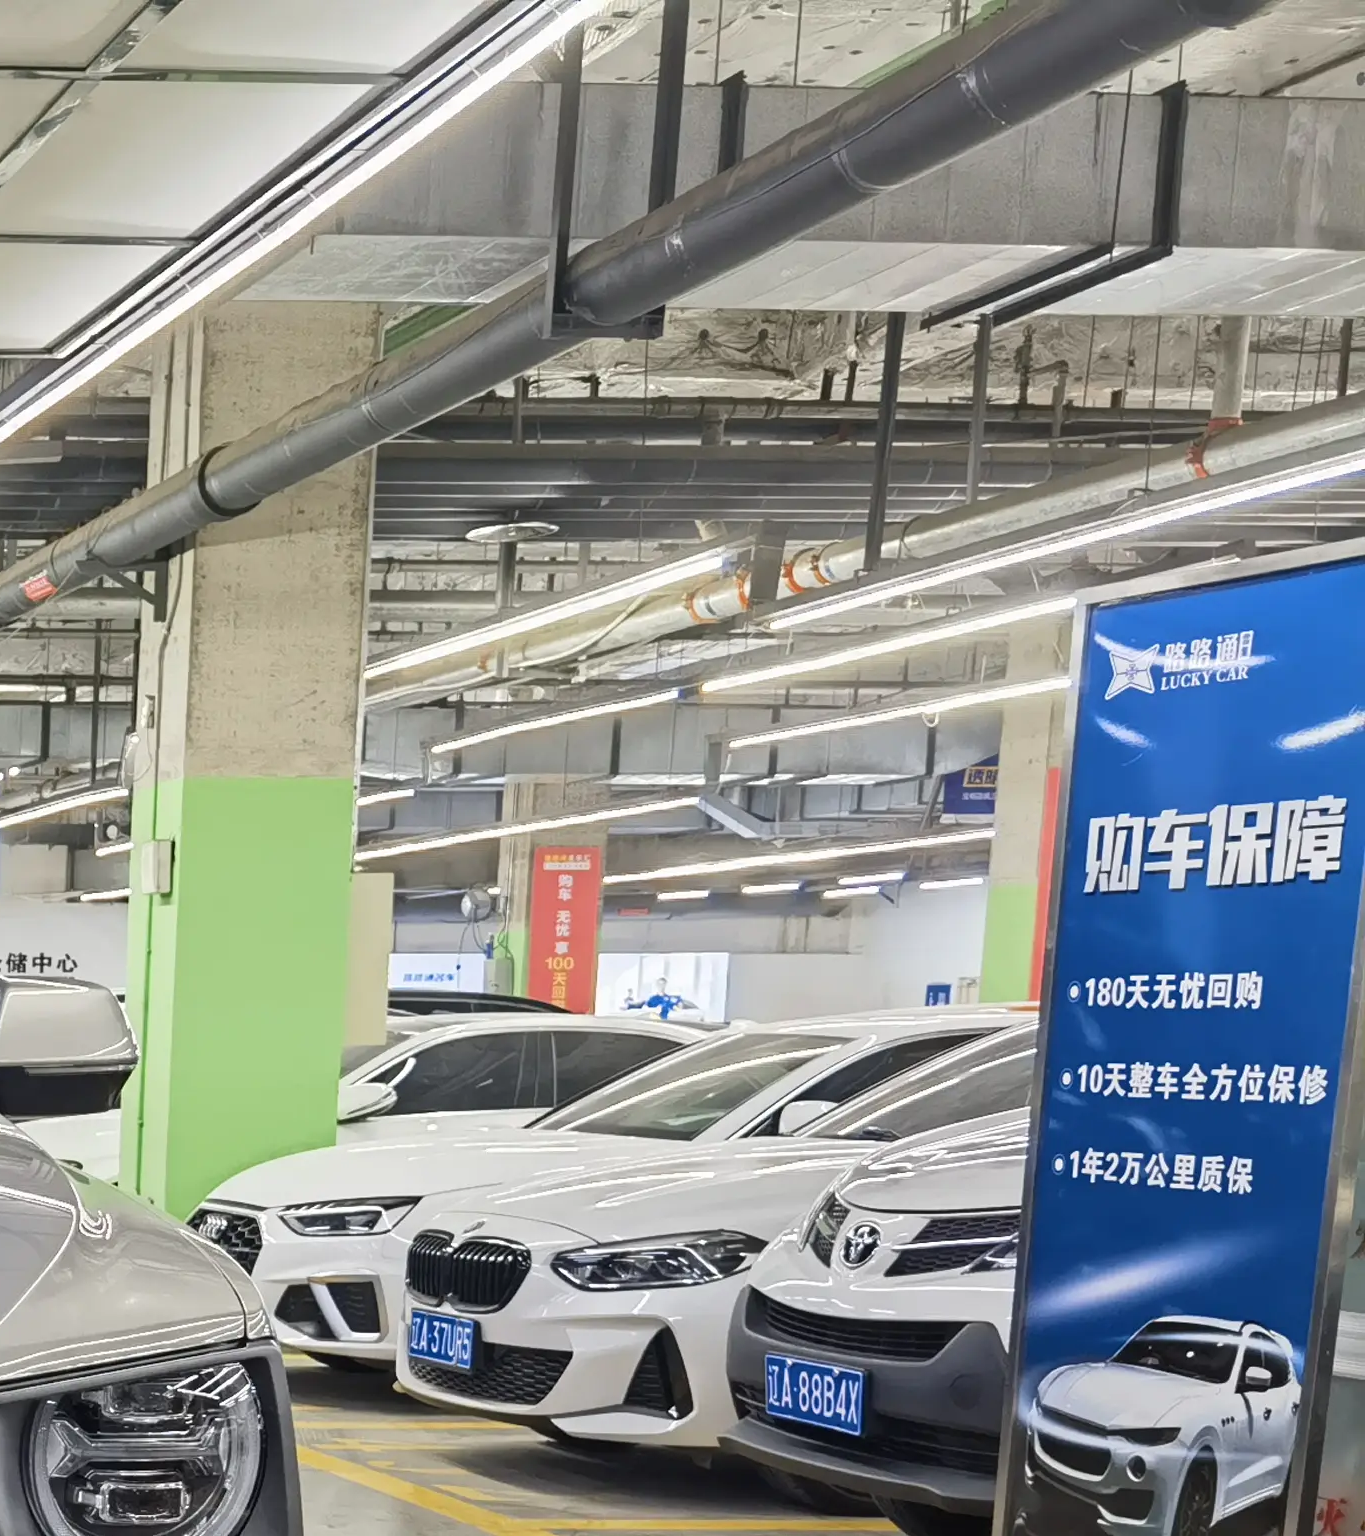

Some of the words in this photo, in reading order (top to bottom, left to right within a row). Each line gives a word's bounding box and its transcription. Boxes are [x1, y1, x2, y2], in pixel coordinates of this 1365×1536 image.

[1160, 668, 1214, 691] LUCKY
[1215, 664, 1249, 683] CAR
[1083, 795, 1347, 893] 购车保障
[1084, 971, 1263, 1009] 180天无忧回购
[1077, 1062, 1328, 1105] 10天整车全方位保修
[1069, 1147, 1254, 1195] 1年2万公里质保
